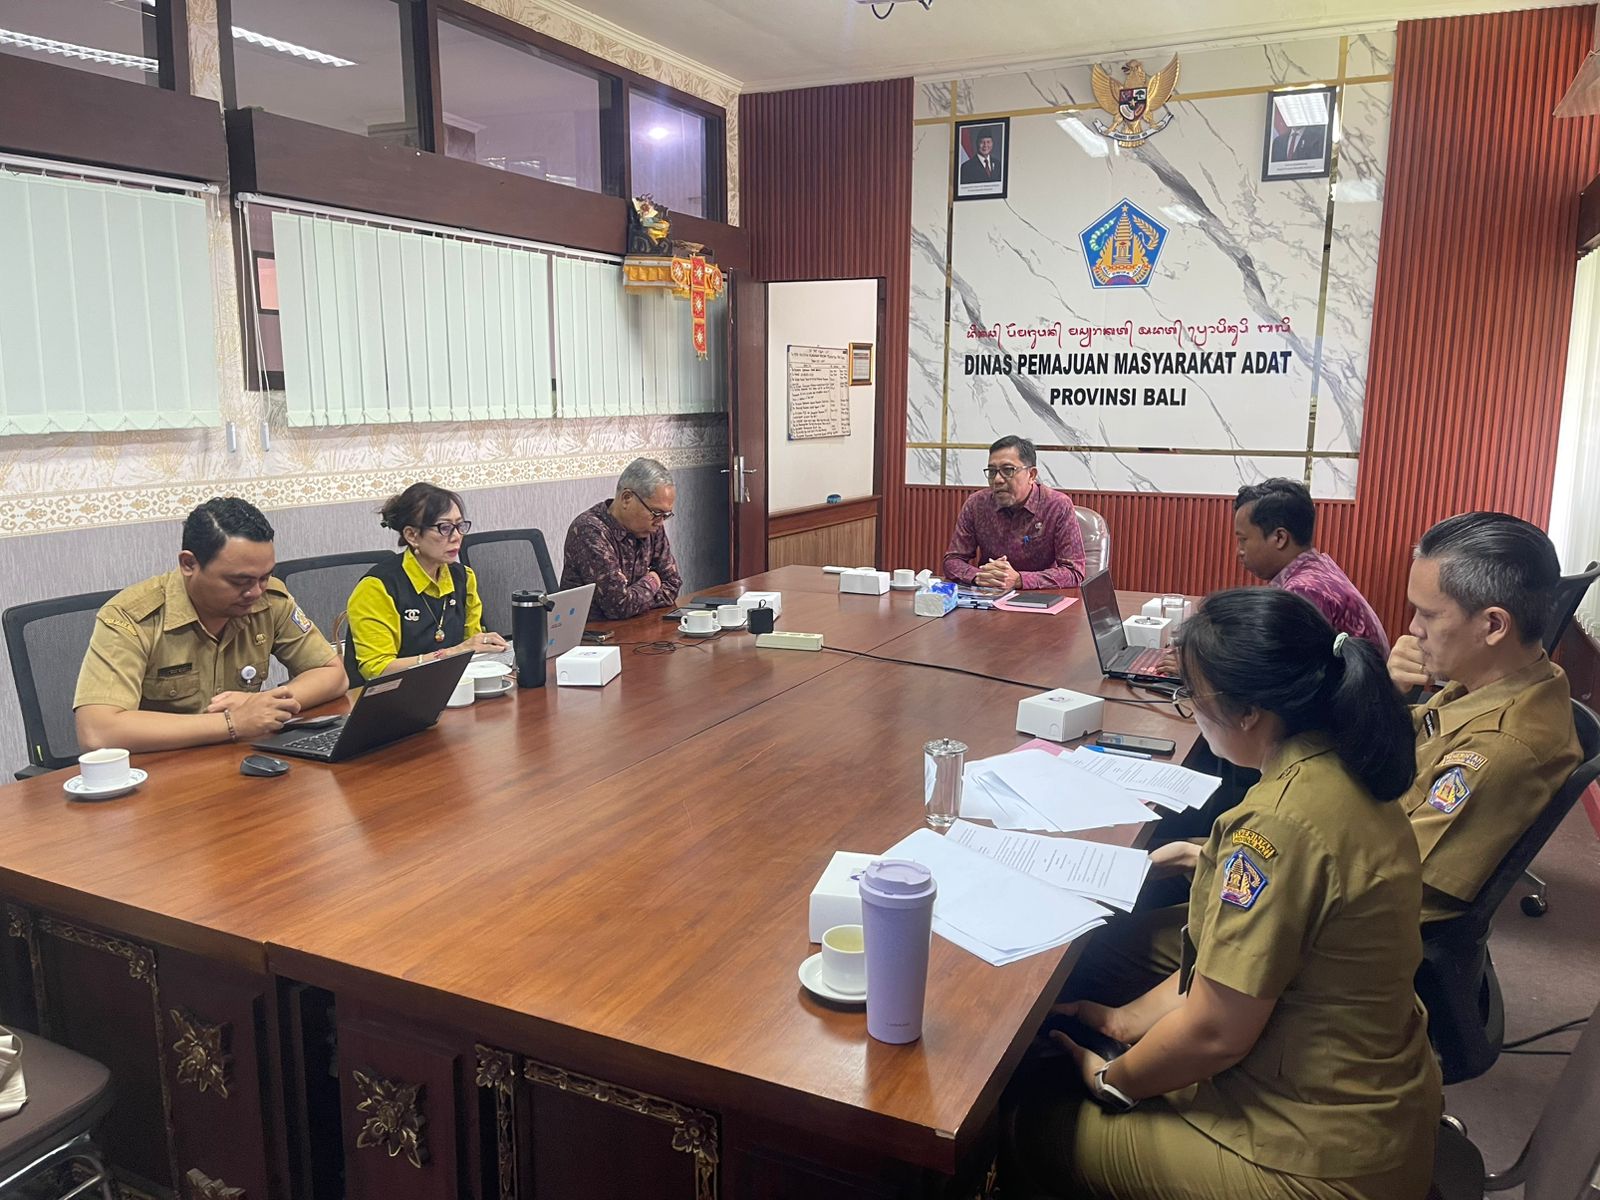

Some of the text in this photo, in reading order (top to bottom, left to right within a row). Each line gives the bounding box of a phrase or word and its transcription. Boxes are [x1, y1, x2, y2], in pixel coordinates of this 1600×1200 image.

[964, 351, 1292, 375] DINAS PEMAJUAN MASYARAKAT ADAT
[1050, 388, 1187, 406] PROVINSI BALI
